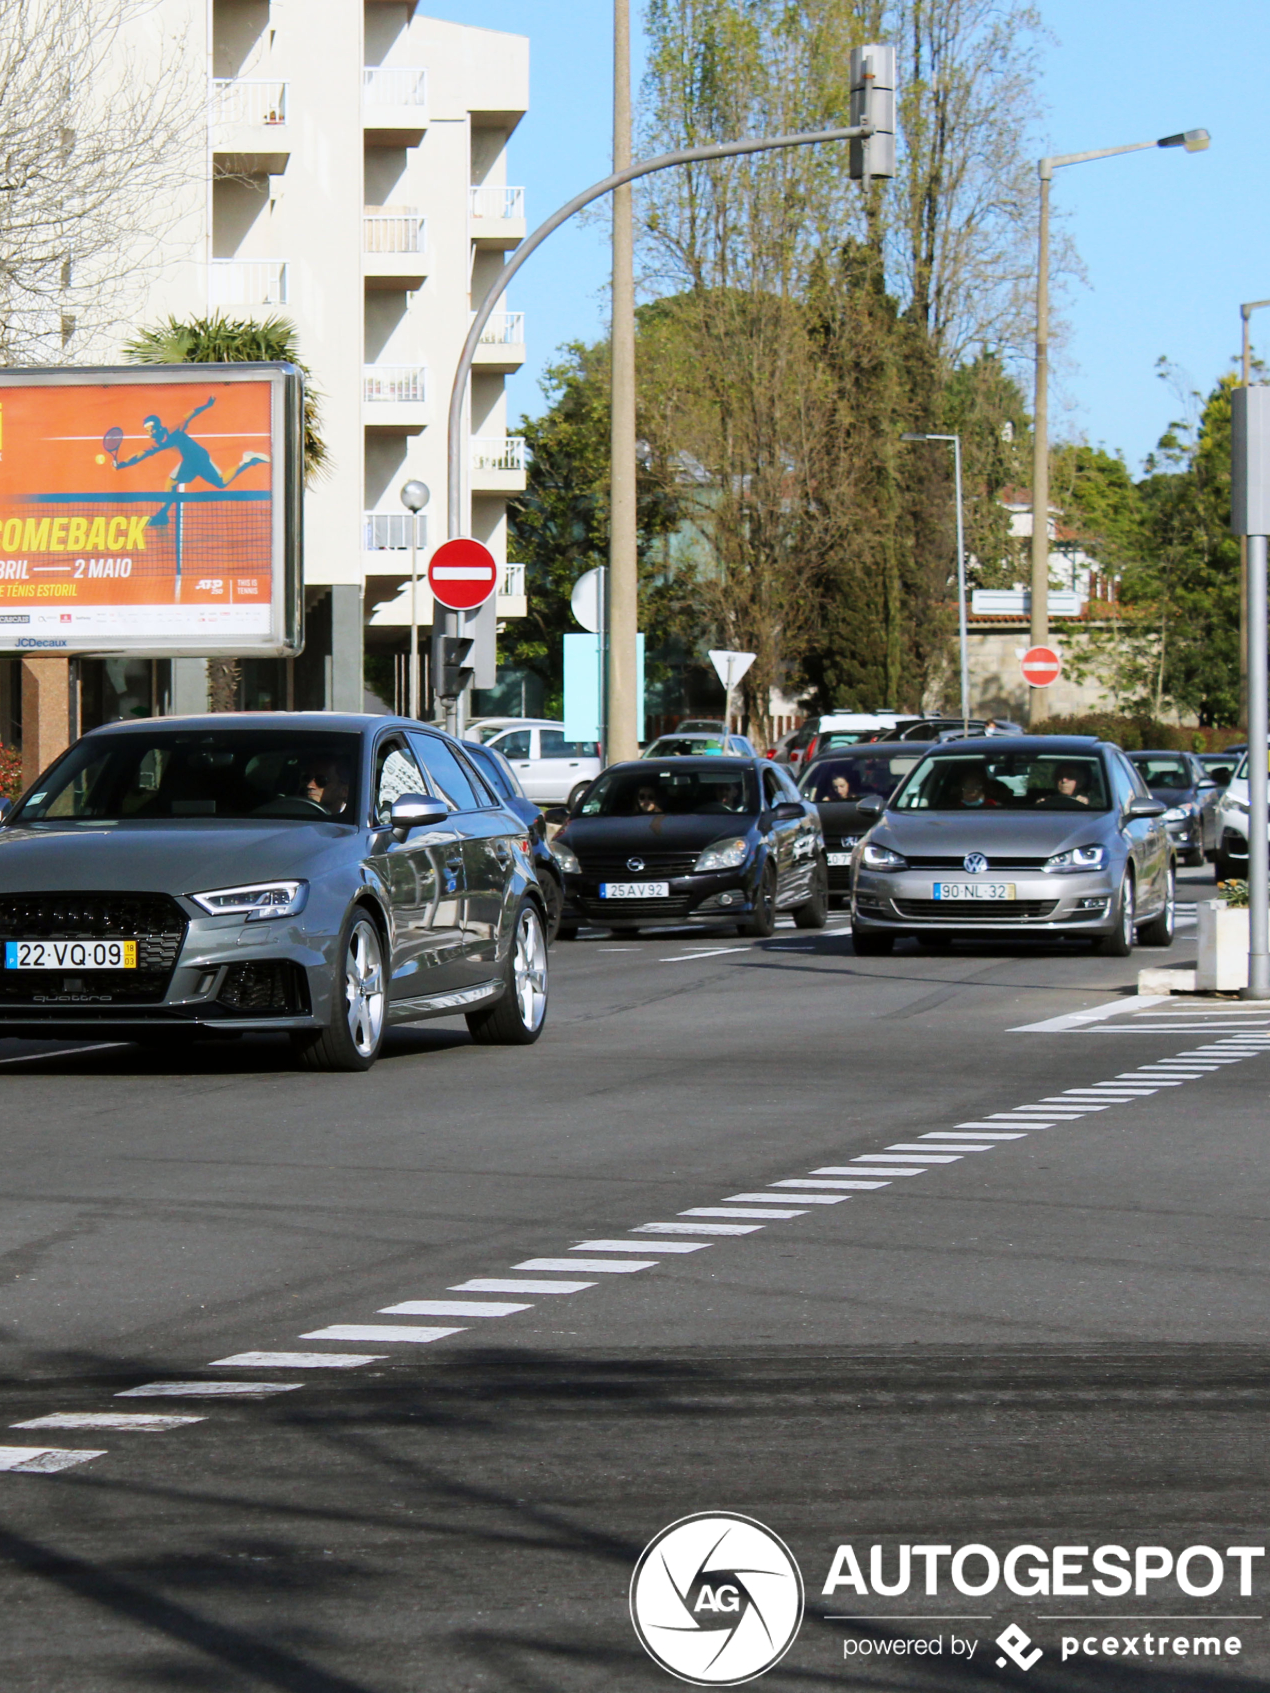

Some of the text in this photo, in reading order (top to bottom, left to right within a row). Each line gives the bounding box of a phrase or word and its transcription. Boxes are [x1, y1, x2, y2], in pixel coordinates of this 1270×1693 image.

[74, 559, 86, 579] 2
[88, 558, 132, 578] MAIO
[195, 579, 223, 589] ATP
[7, 582, 35, 597] TÉNIS
[37, 584, 78, 597] ESTORIL
[15, 638, 67, 647] JCDecaux
[124, 958, 134, 966] 03
